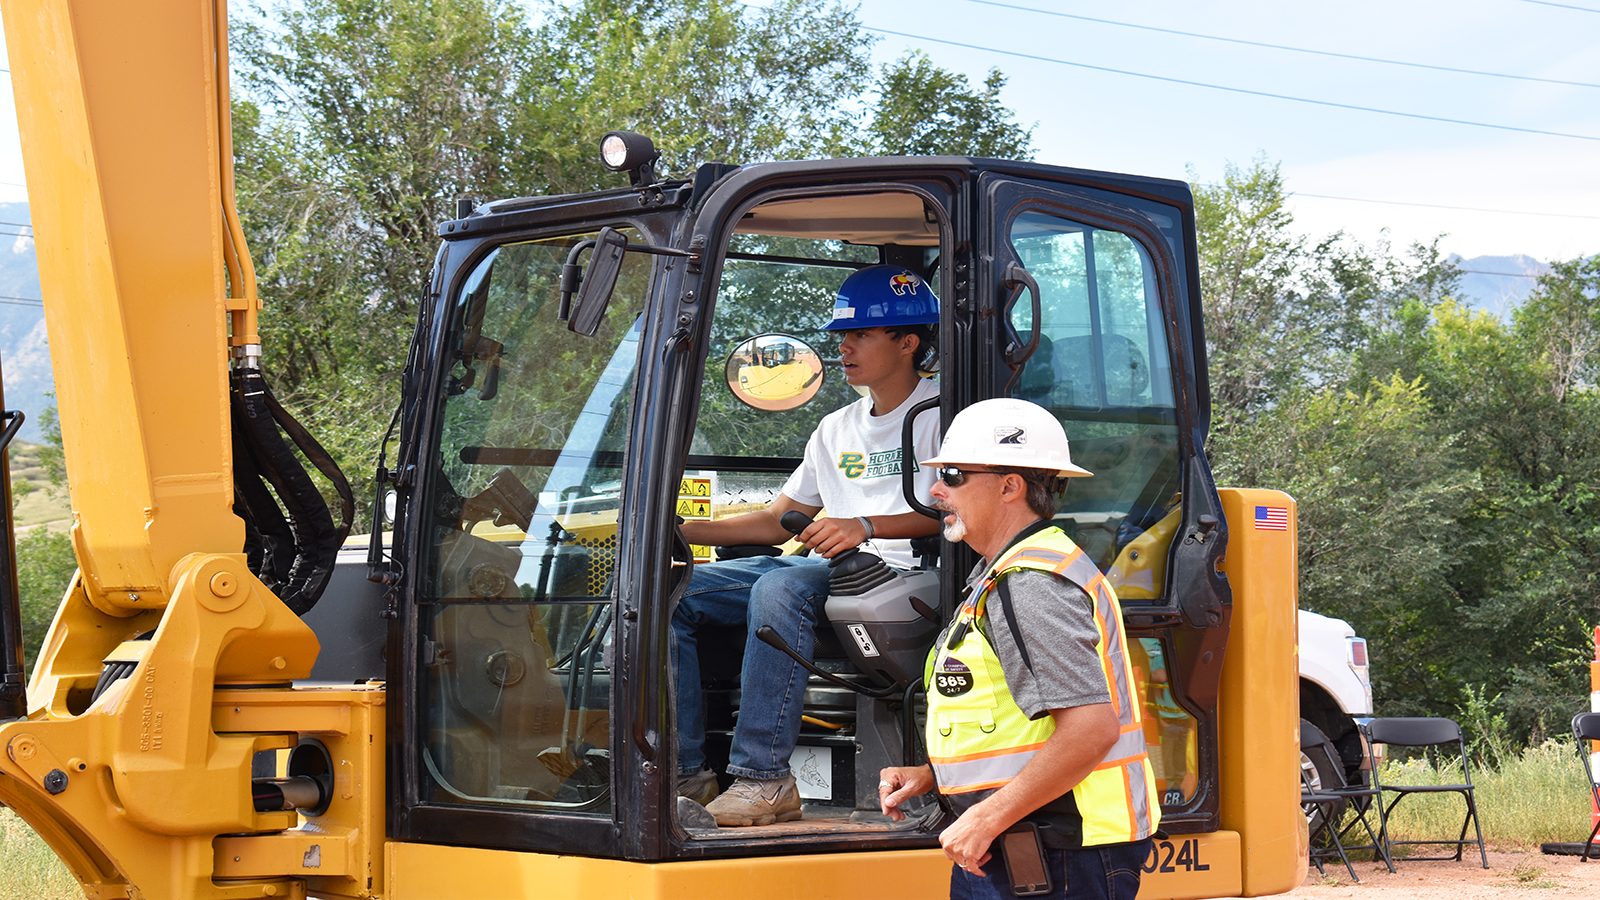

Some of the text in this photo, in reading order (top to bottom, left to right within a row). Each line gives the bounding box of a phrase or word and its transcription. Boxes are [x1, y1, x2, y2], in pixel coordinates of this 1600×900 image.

[246, 399, 257, 419] CAT
[868, 450, 902, 465] HORNE
[838, 452, 866, 480] PC
[937, 675, 967, 688] 365
[1163, 791, 1180, 806] CR
